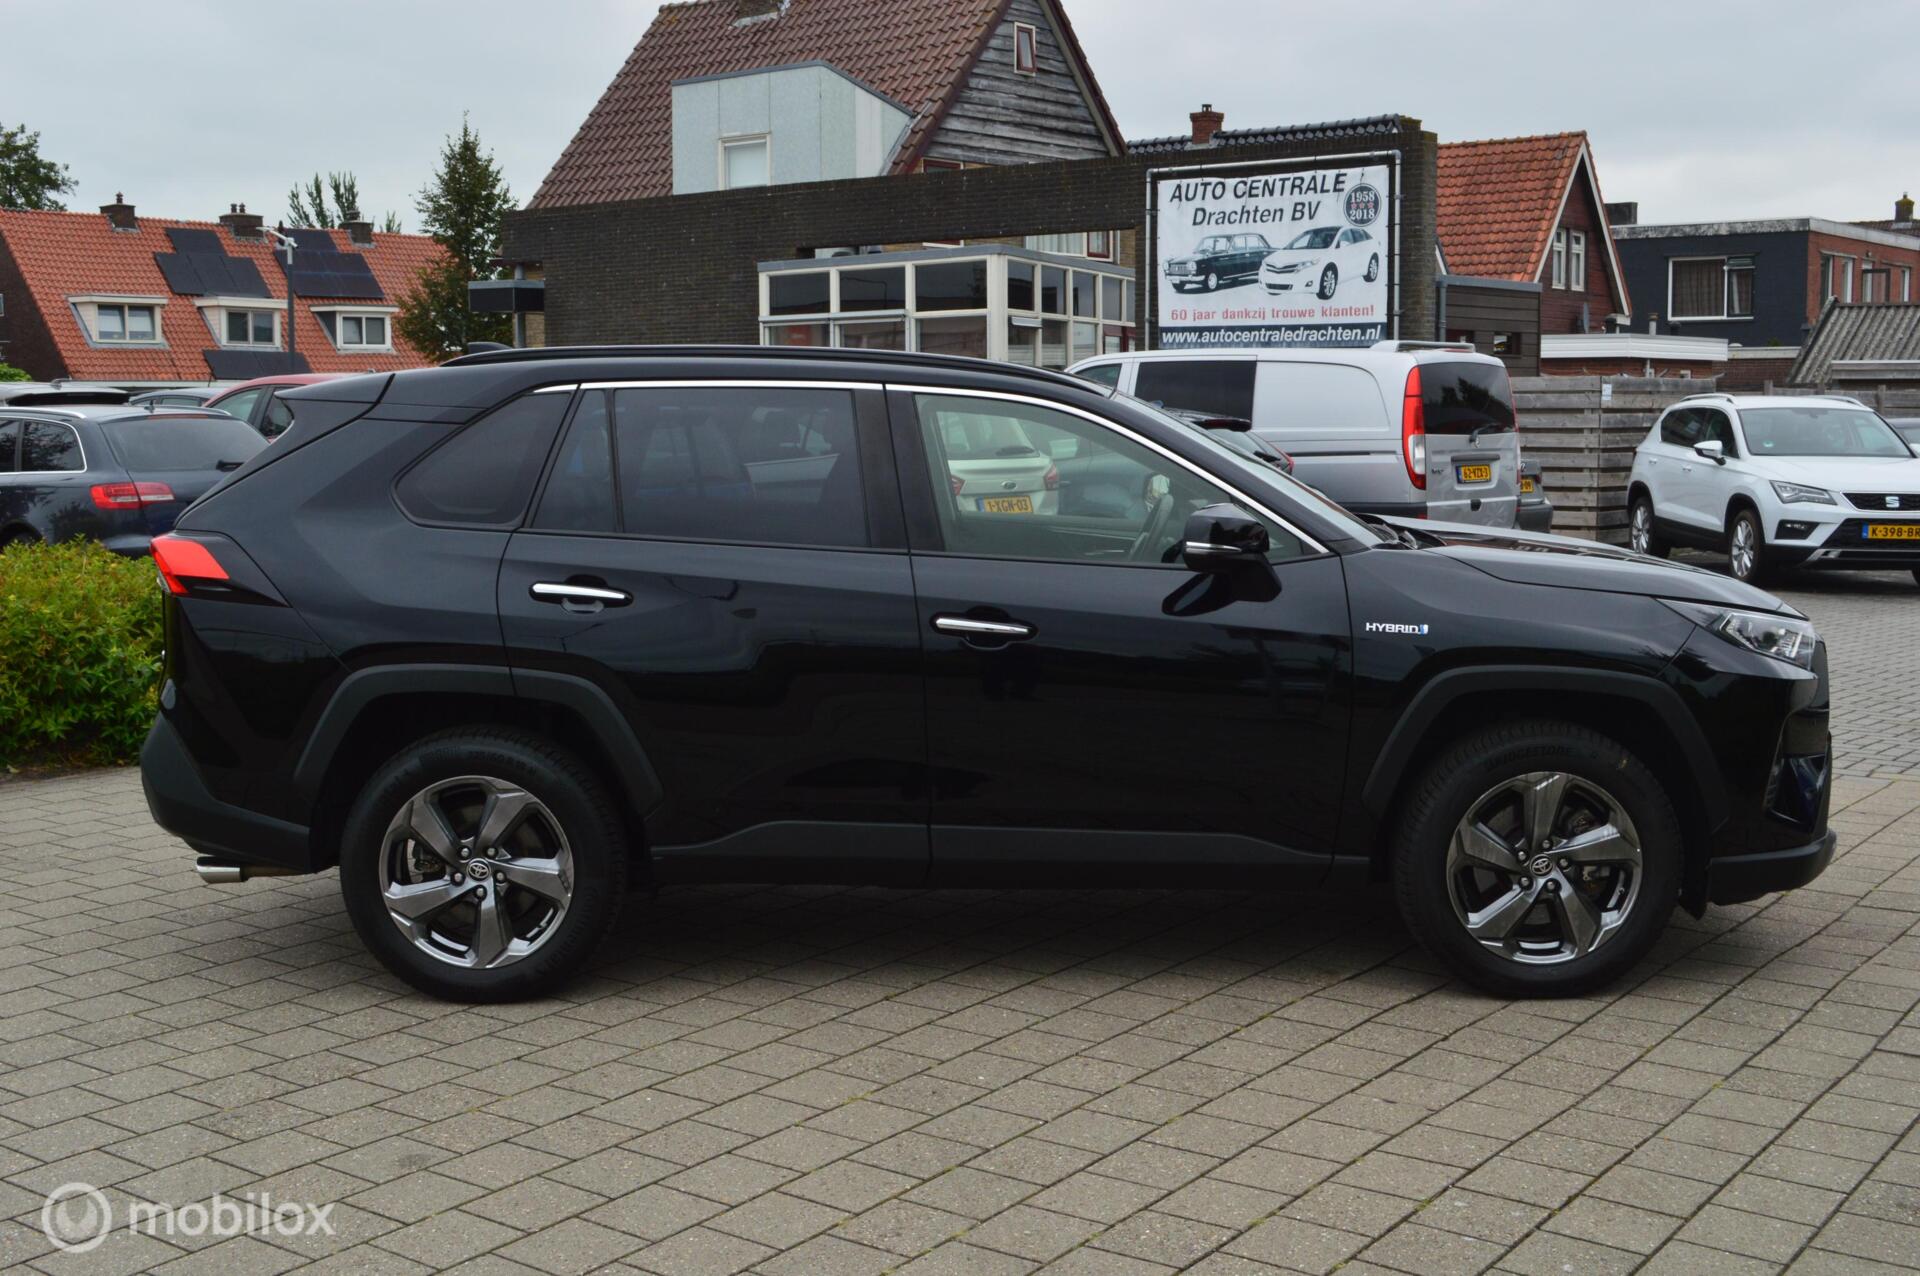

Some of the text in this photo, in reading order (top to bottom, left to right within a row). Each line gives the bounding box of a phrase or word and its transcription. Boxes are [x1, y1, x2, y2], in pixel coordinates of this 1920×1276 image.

[1169, 173, 1347, 202] AUTO CENTRALE
[1350, 190, 1375, 202] 1958
[1192, 201, 1321, 226] Drachten BV
[1350, 208, 1375, 220] 2018
[1170, 304, 1375, 322] 60 jaar dankzij trouwe klanten!
[1162, 325, 1382, 343] www.autocentraledrachten.nl
[987, 499, 1030, 512] 1-XGN-03
[1365, 622, 1420, 635] HYBRID
